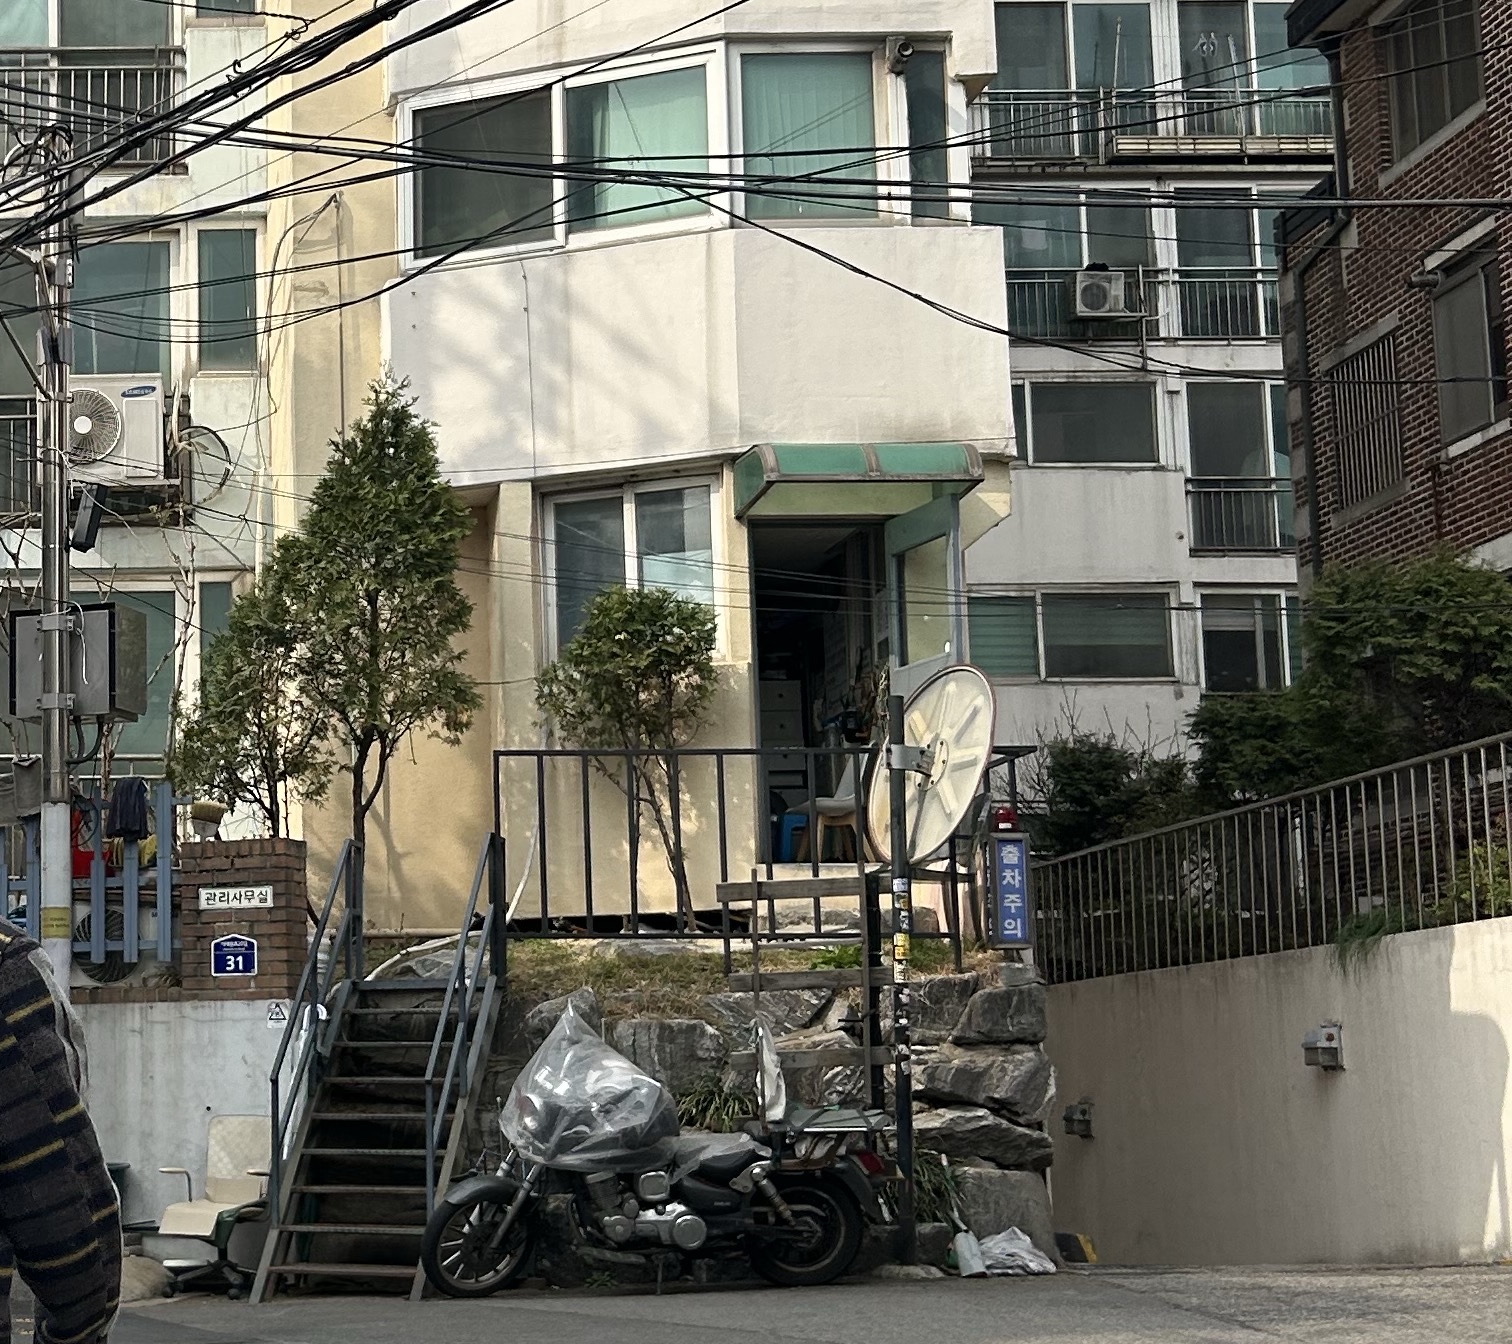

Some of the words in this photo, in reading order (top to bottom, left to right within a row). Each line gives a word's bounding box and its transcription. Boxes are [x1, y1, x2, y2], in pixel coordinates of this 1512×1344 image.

[204, 889, 269, 906] 관리사무실
[1000, 843, 1023, 939] 출차주의
[225, 955, 244, 971] 31
